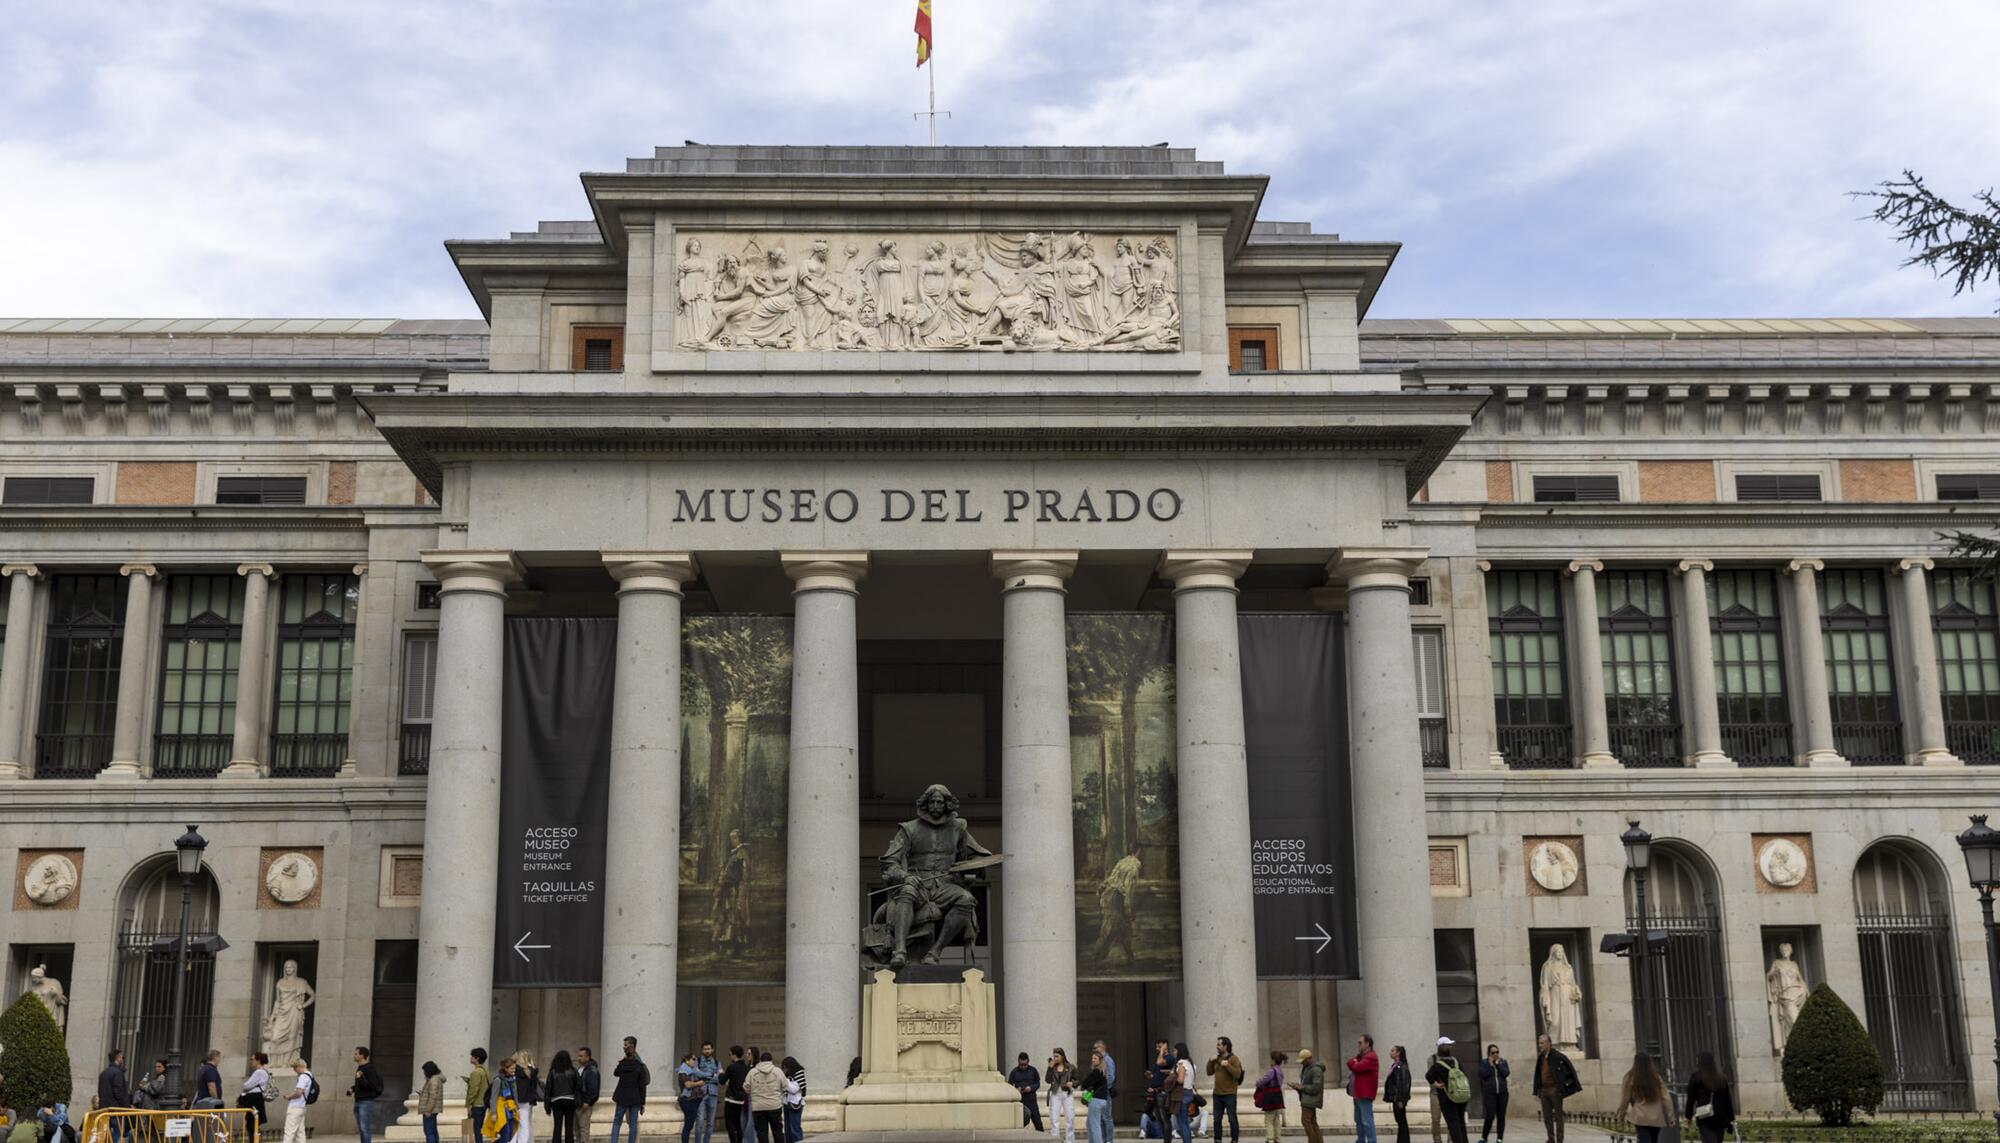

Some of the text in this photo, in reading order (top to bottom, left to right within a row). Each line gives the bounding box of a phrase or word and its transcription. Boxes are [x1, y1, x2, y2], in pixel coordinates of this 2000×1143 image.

[672, 488, 1182, 522] MUSEO DEL PRADO
[525, 827, 578, 838] ACCESO
[524, 840, 570, 850] MUSEO
[1252, 840, 1306, 850] ACCESO
[1252, 852, 1306, 862] GRUPOS
[523, 862, 572, 870] ENTRANCE
[1252, 864, 1333, 874] EDUCATIVOS
[523, 881, 595, 892] TAQUILLAS
[1254, 886, 1335, 894] GROUP ENTRANCE
[522, 894, 588, 902] TICKET OFFICE
